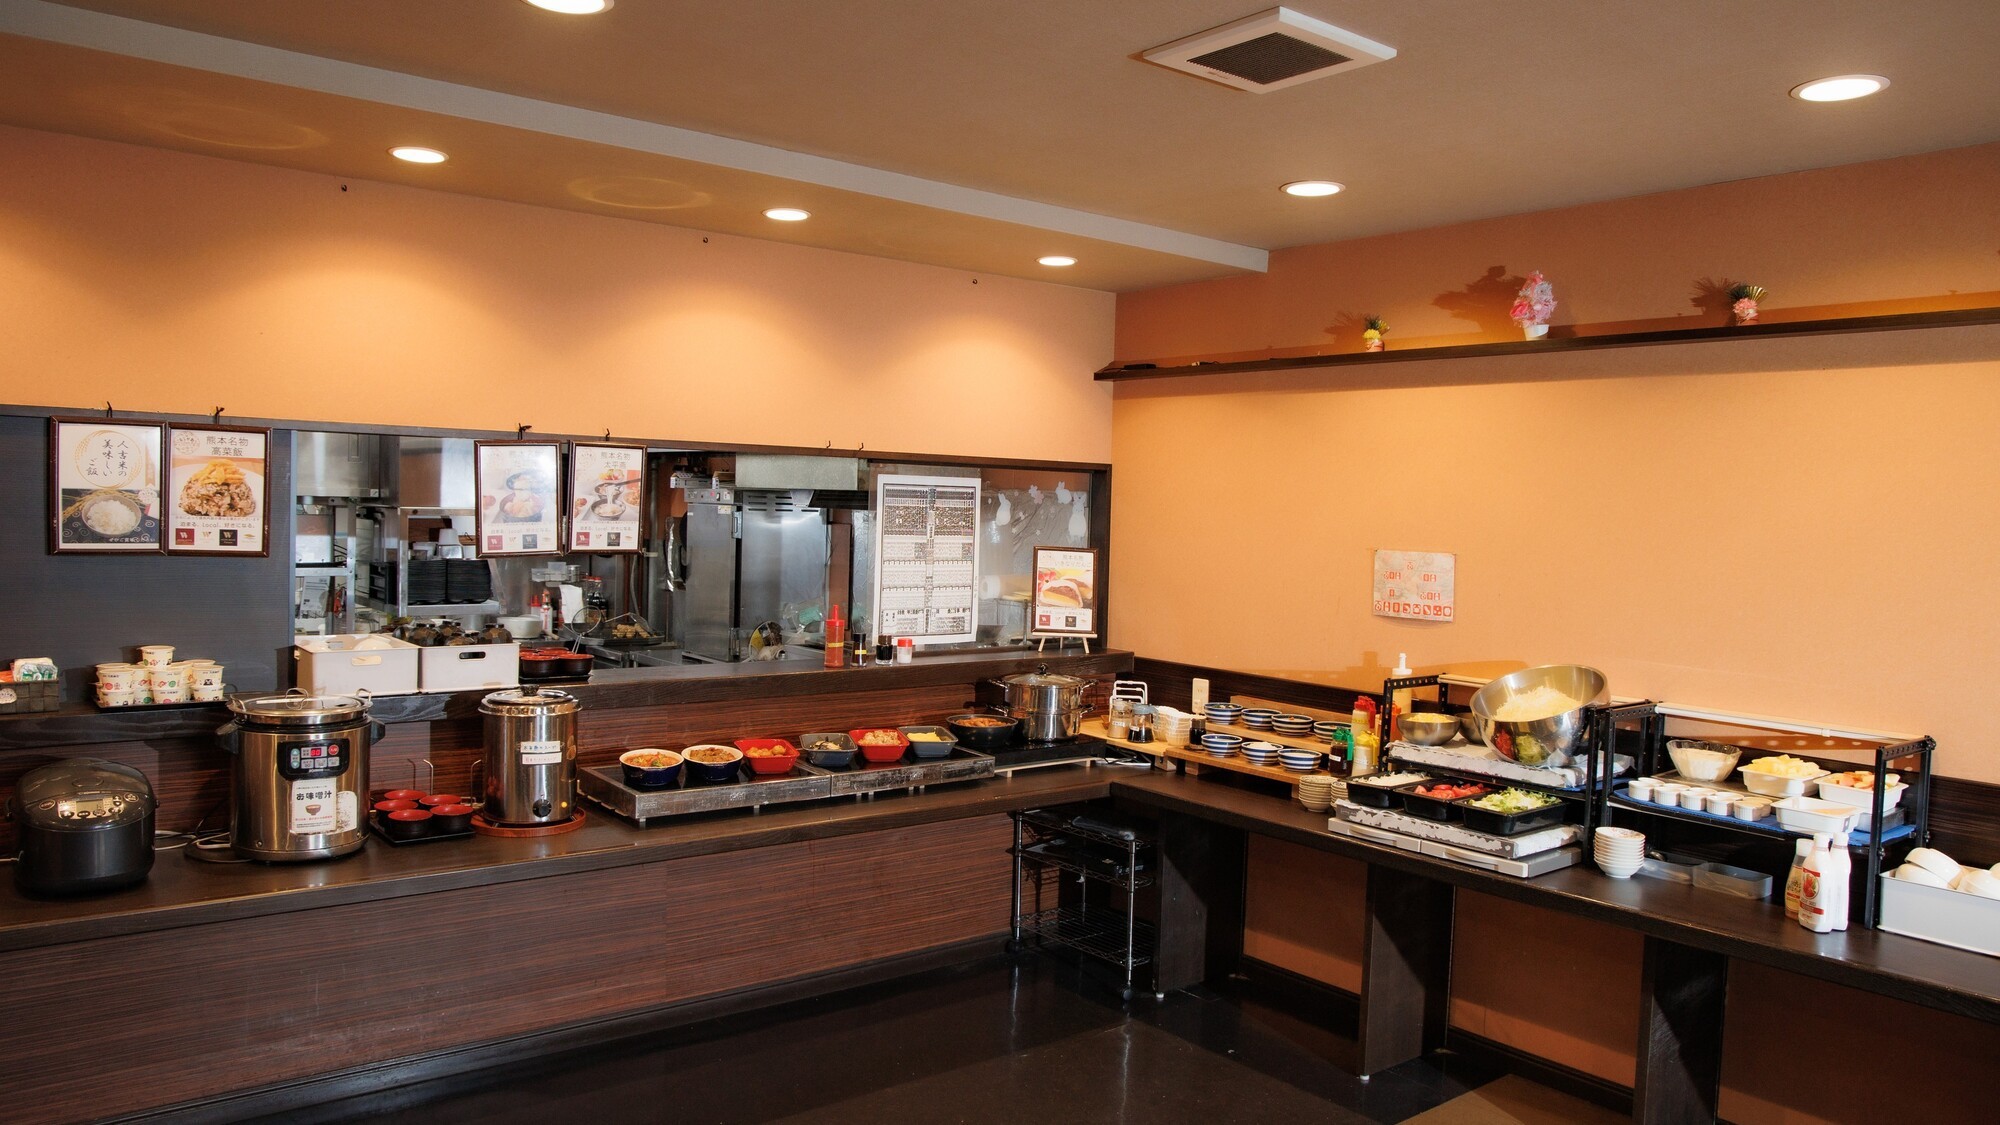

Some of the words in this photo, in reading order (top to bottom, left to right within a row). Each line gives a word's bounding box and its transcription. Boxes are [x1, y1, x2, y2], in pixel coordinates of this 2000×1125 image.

[206, 436, 249, 446] 熊本名物
[102, 439, 114, 477] 美味しい
[117, 440, 129, 476] 人吉米の
[211, 447, 243, 456] 高菜飯
[86, 457, 99, 476] ご飯
[296, 790, 332, 801] お味噌汁
